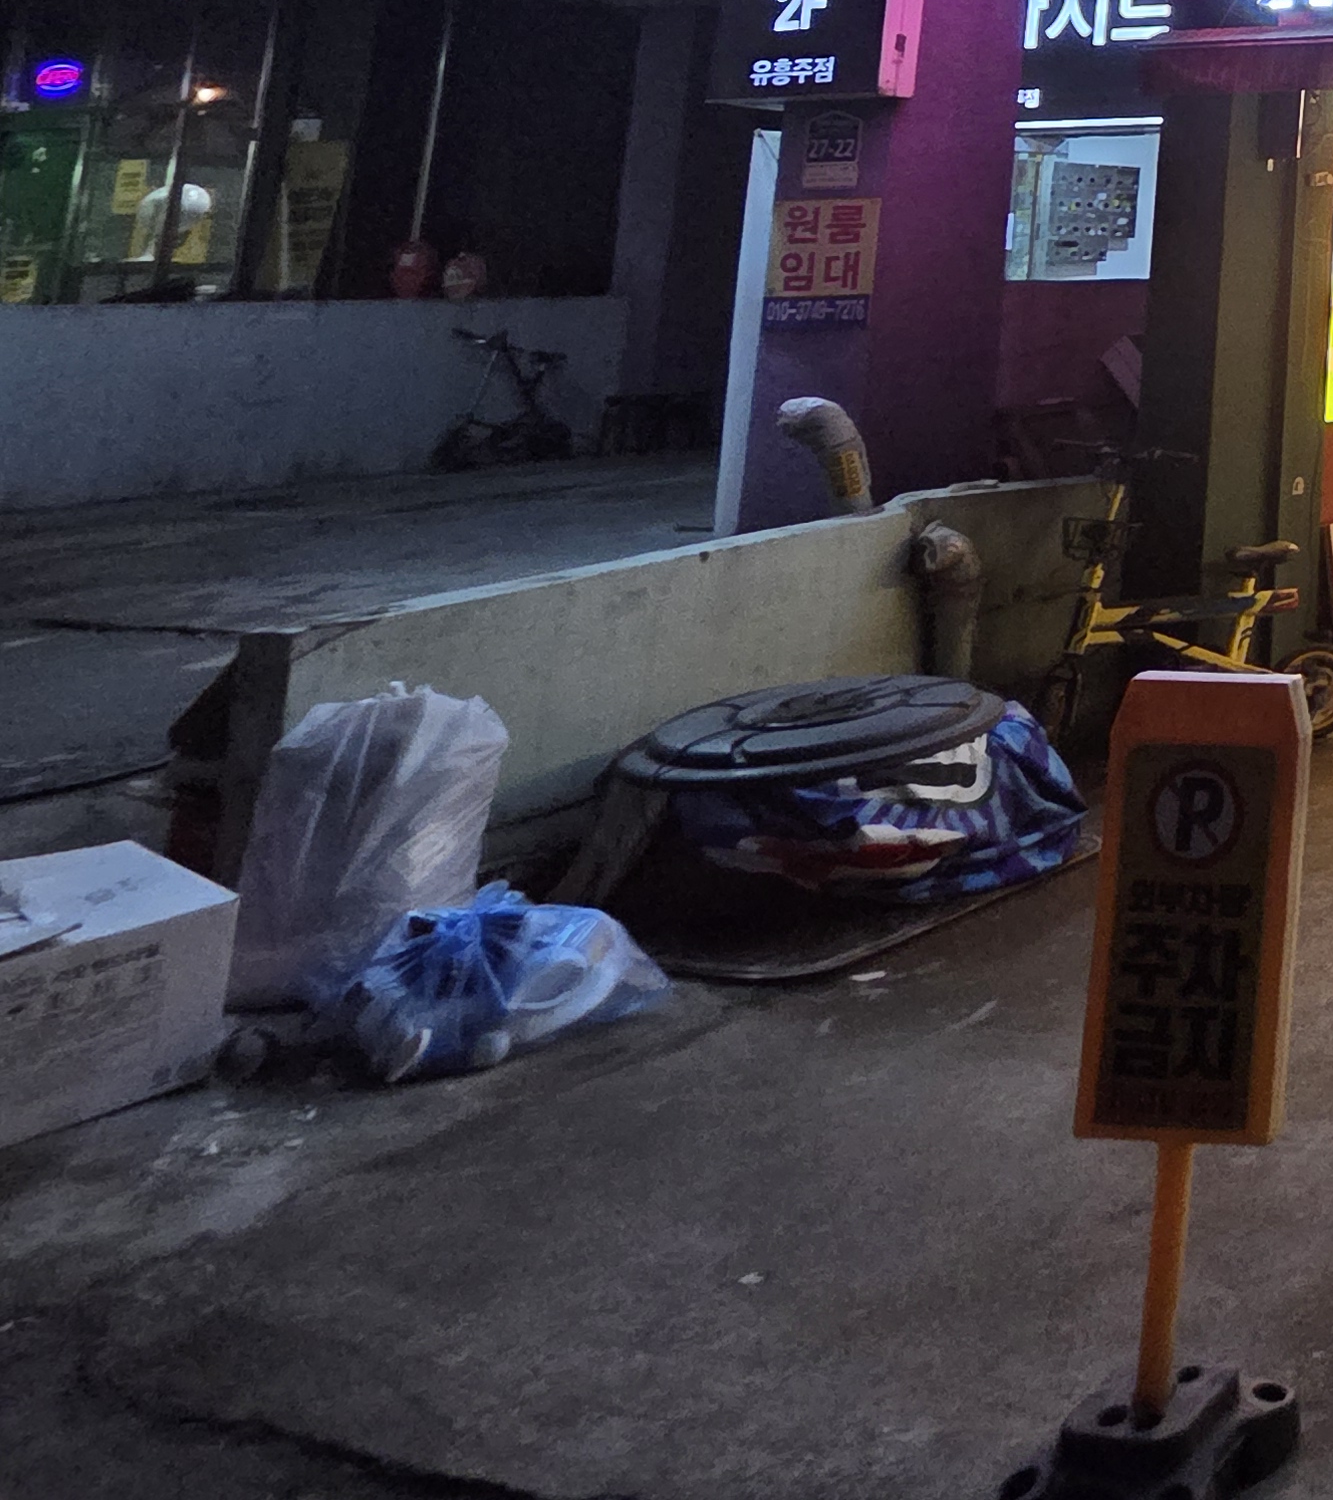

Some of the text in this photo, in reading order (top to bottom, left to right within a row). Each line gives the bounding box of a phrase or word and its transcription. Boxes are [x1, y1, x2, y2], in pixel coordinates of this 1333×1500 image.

[750, 56, 835, 86] 유흥주점
[808, 138, 855, 159] 27-22
[784, 204, 866, 244] 원룸
[780, 251, 861, 291] 임대
[1121, 923, 1250, 1001] 주차
[1112, 1004, 1238, 1080] 금지
